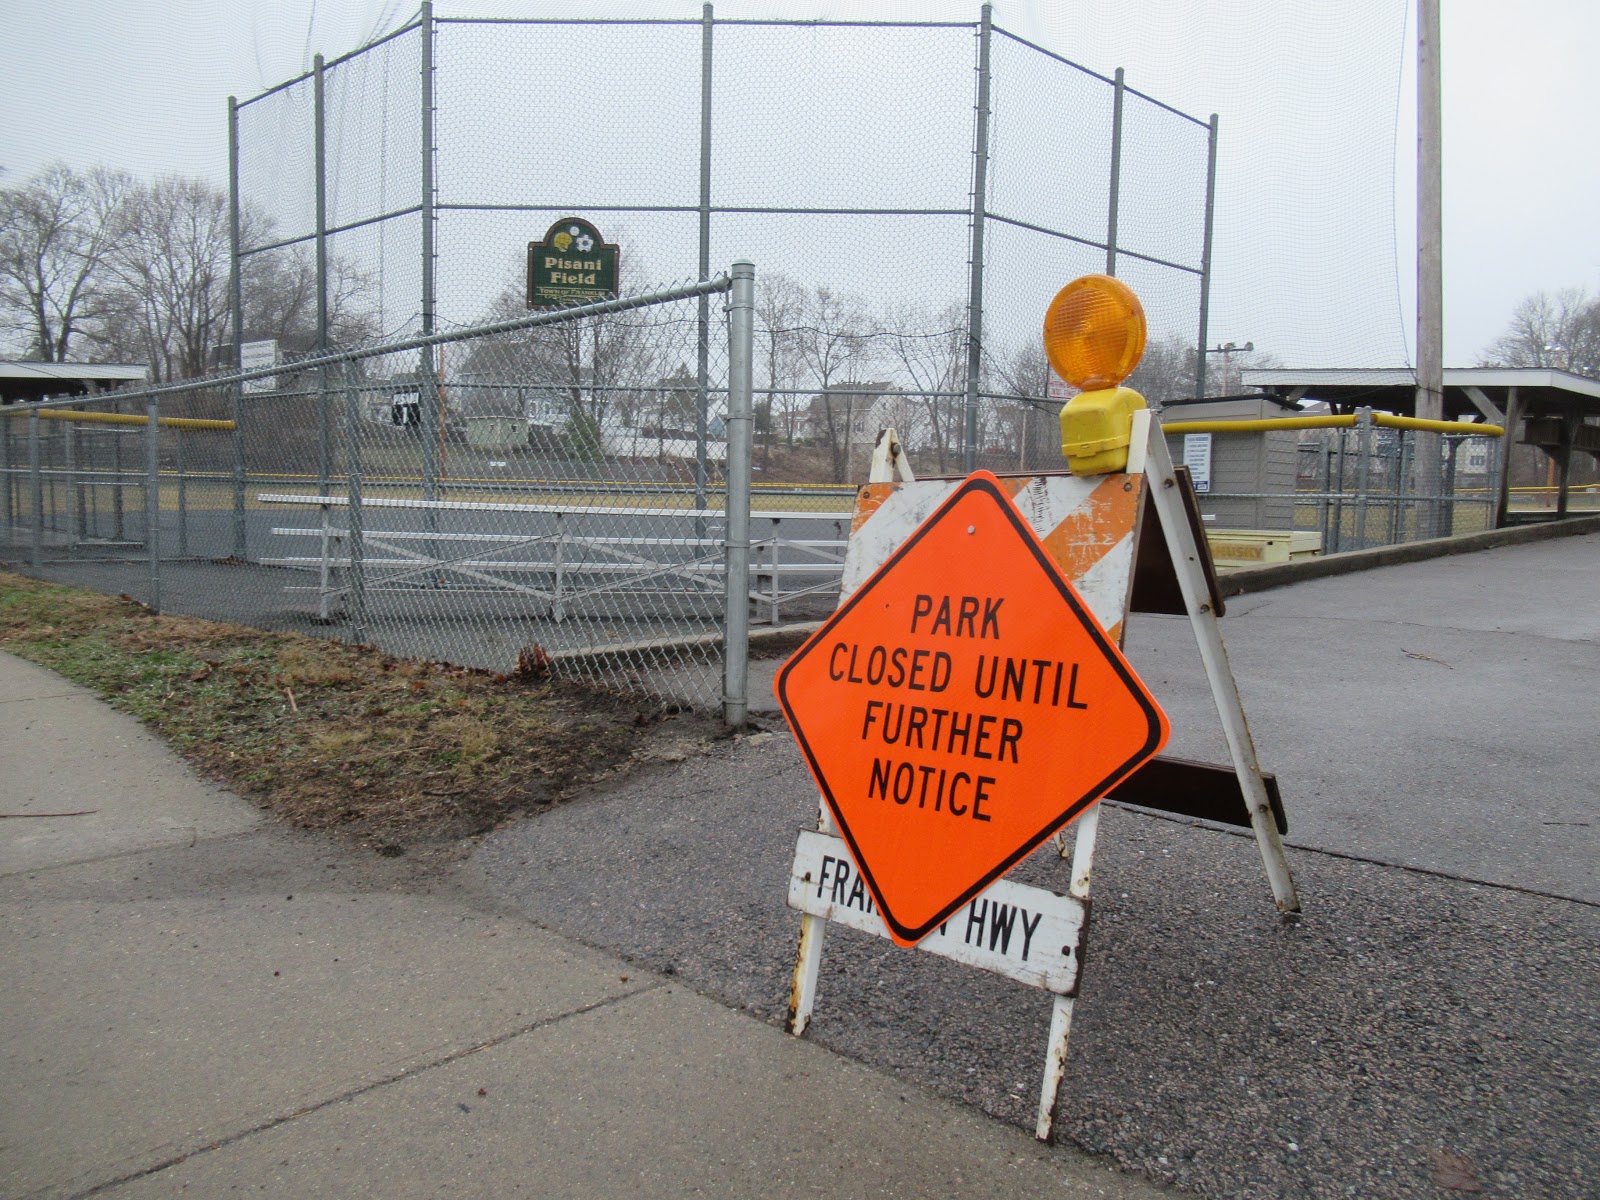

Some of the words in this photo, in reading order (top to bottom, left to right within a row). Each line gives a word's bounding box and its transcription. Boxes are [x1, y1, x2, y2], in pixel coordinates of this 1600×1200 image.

[544, 257, 602, 271] Pisani
[550, 271, 596, 285] Field
[910, 594, 1005, 640] PARK
[829, 642, 952, 693] CLOSED
[974, 654, 1089, 710] UNTIL
[861, 700, 1023, 764] FURTHER
[867, 757, 996, 822] NOTICE
[964, 897, 1043, 961] HWY
